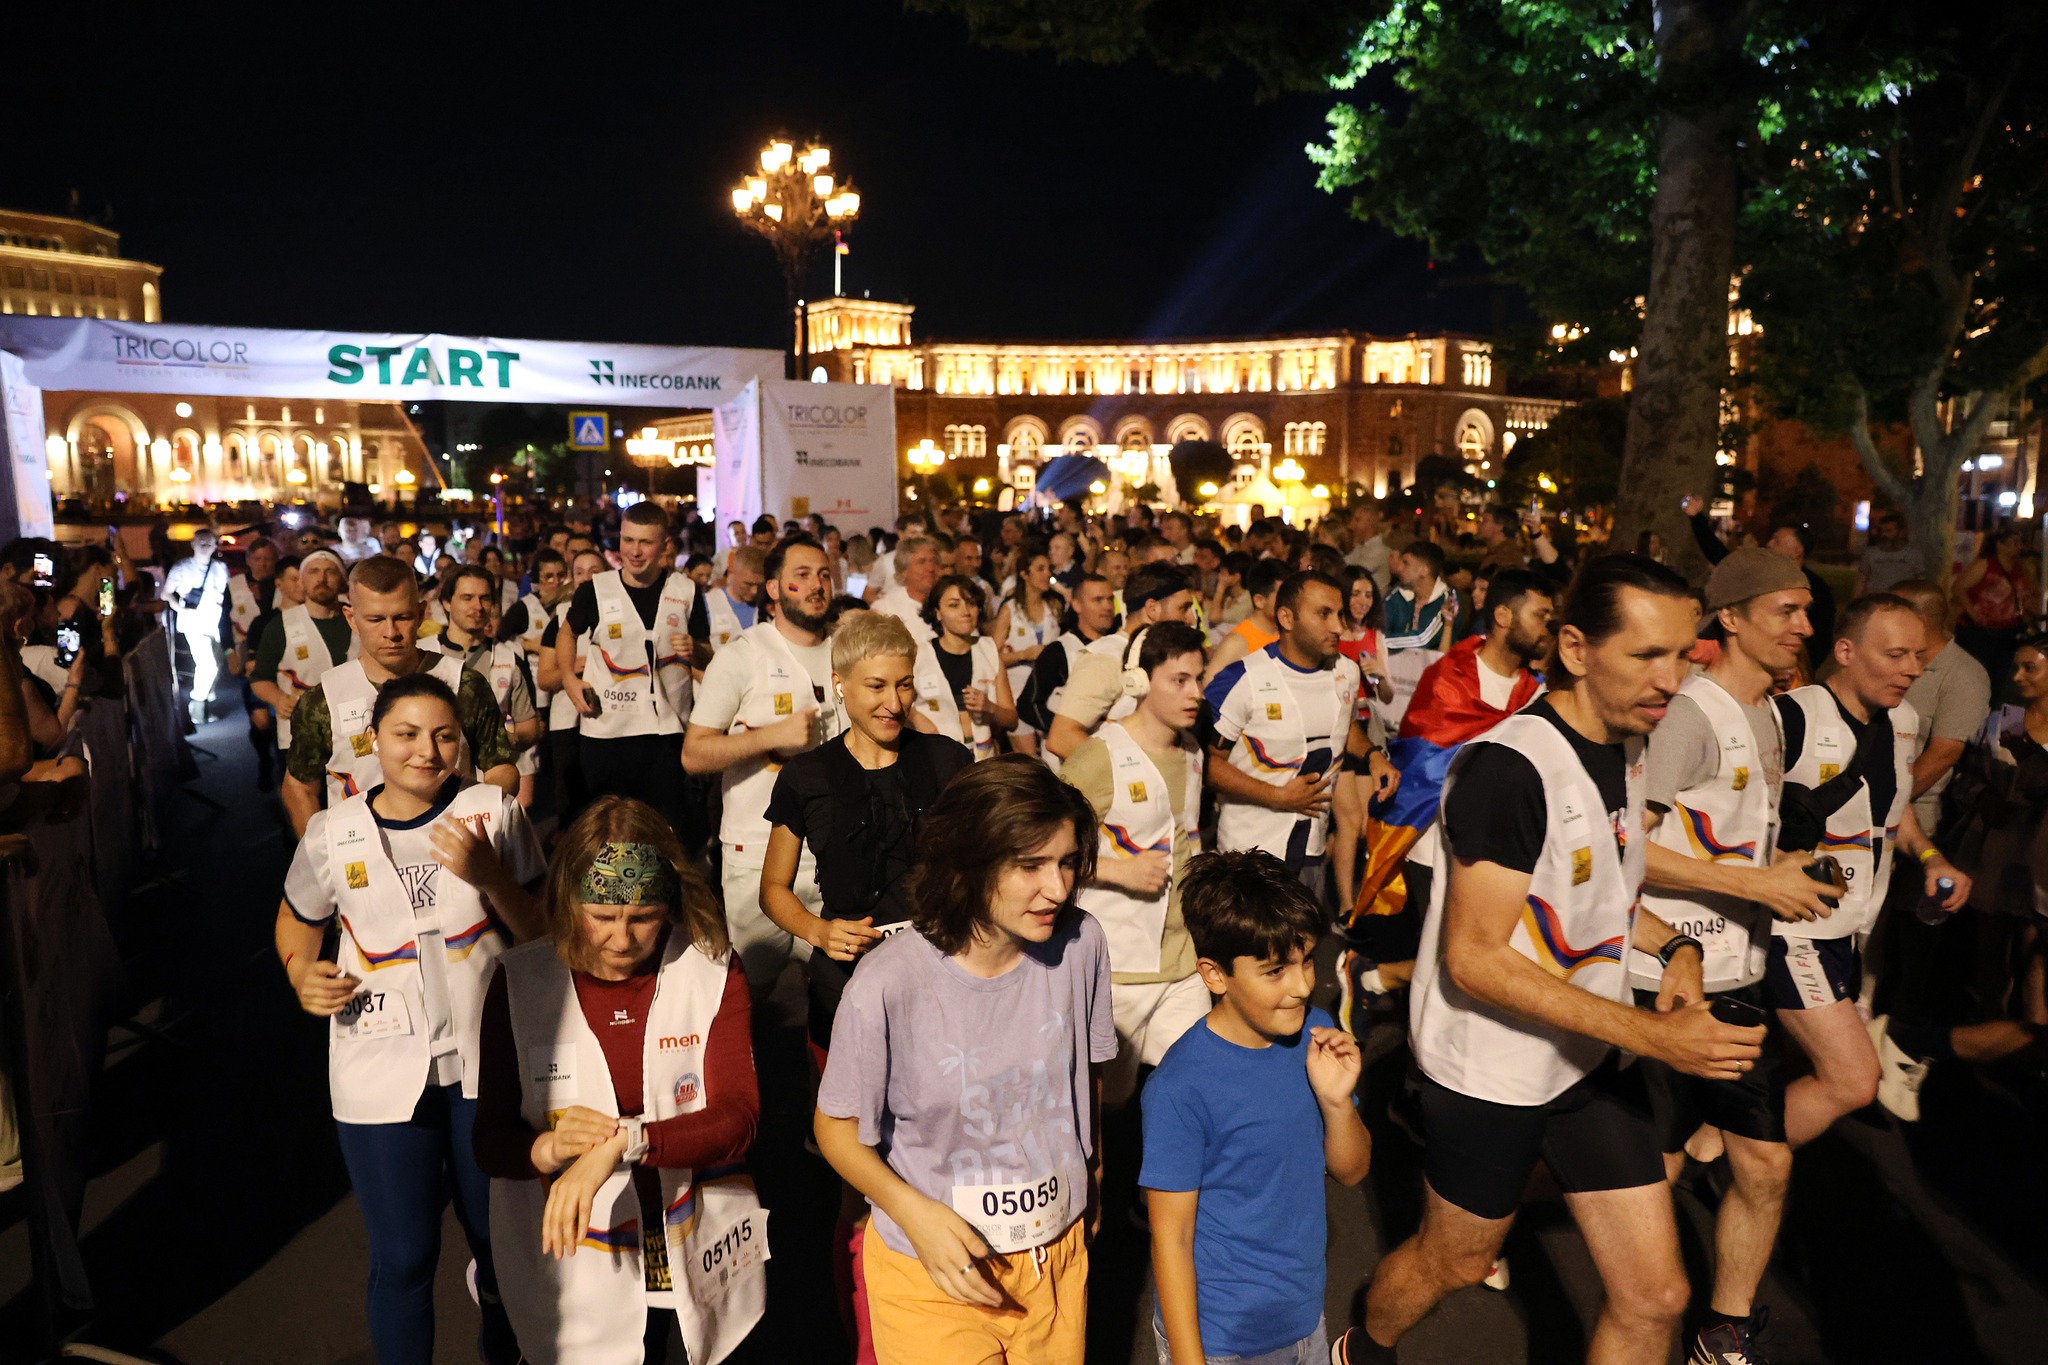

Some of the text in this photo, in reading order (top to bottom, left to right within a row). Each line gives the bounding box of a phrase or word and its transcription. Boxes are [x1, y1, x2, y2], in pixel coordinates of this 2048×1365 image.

[113, 335, 248, 364] TRICOLOR
[327, 344, 521, 388] START
[620, 373, 721, 391] INECOBANK
[788, 405, 868, 424] TRICOLOR
[604, 689, 637, 702] 05052
[982, 1175, 1058, 1217] 05059
[702, 1218, 752, 1273] 05115
